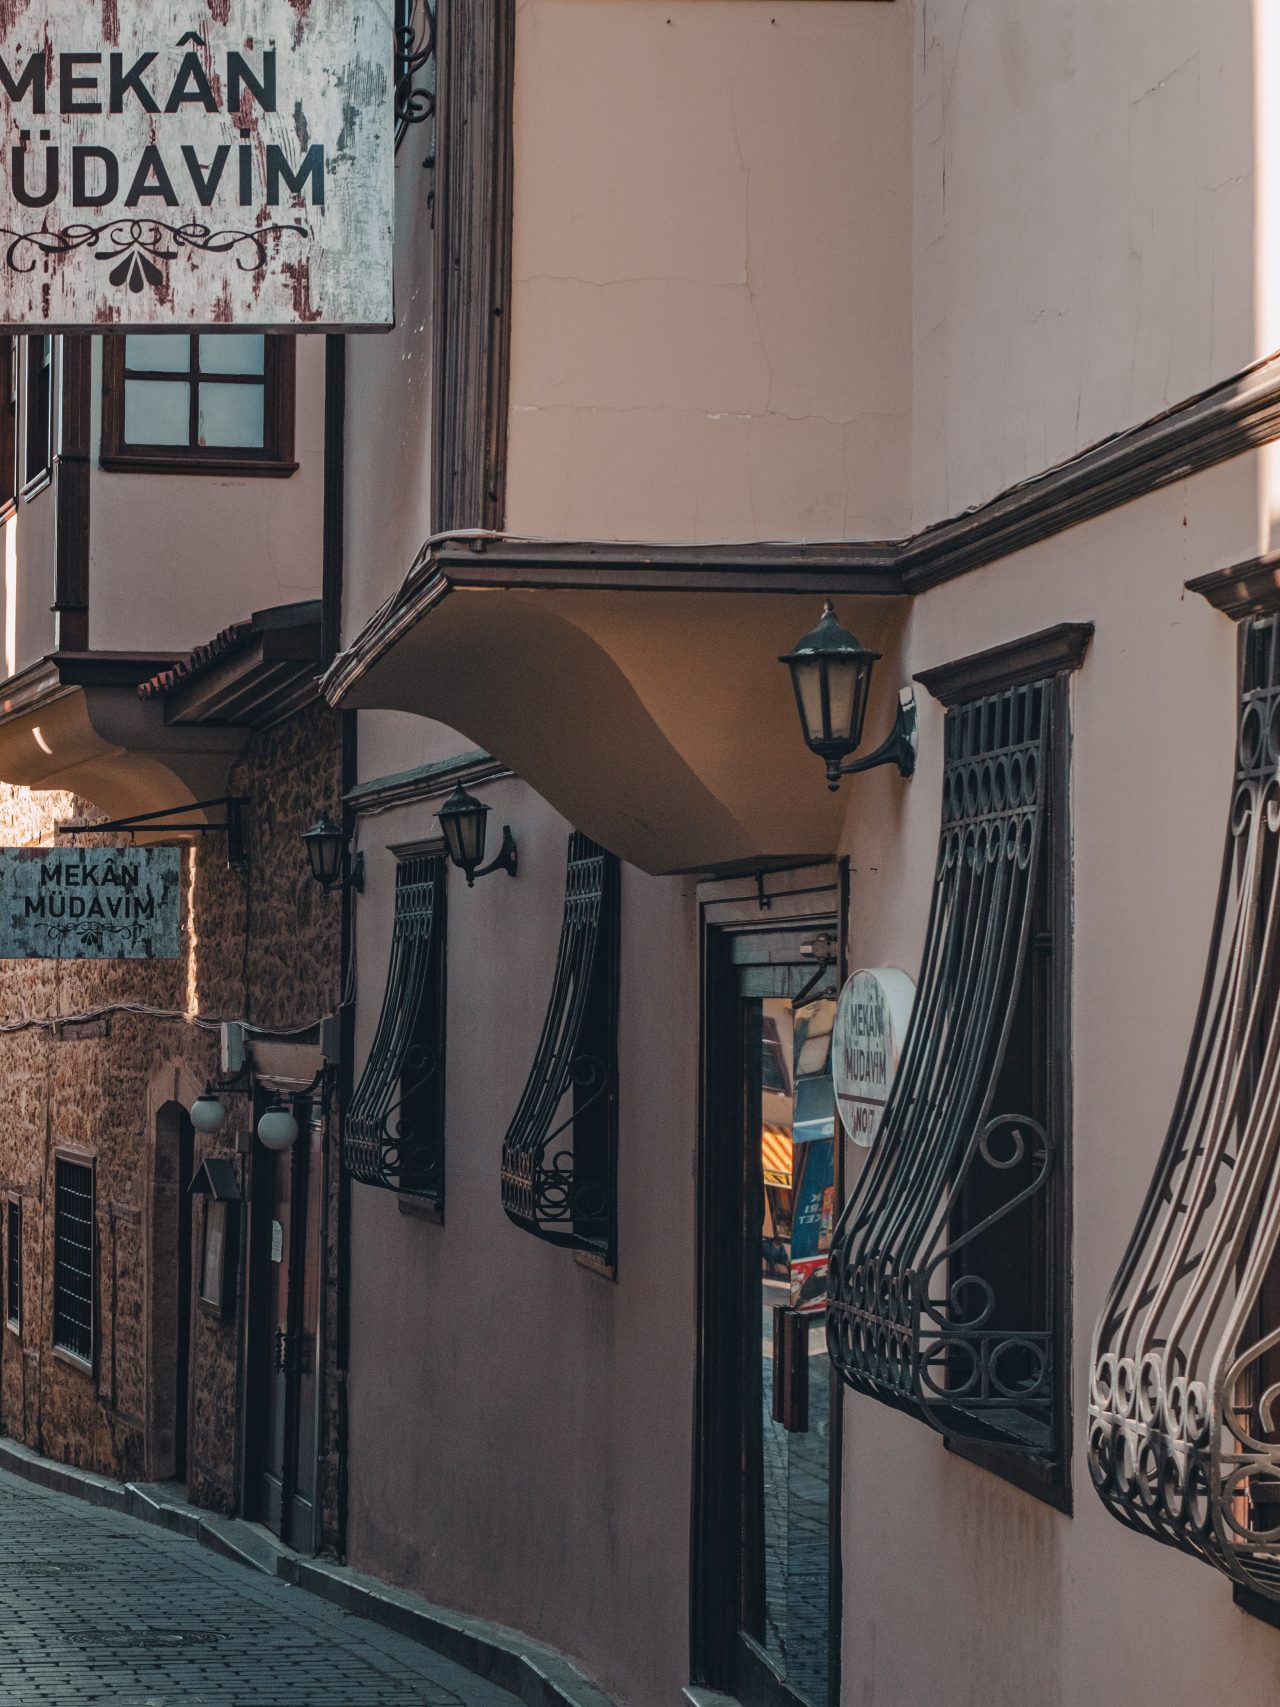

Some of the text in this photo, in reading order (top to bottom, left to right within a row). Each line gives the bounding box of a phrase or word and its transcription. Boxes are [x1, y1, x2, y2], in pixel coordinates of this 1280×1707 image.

[40, 858, 139, 887] MEKÂN
[24, 890, 155, 919] MÜDAVİM
[850, 994, 885, 1038] MEKÂN
[844, 1039, 887, 1086] MÜDAVİM
